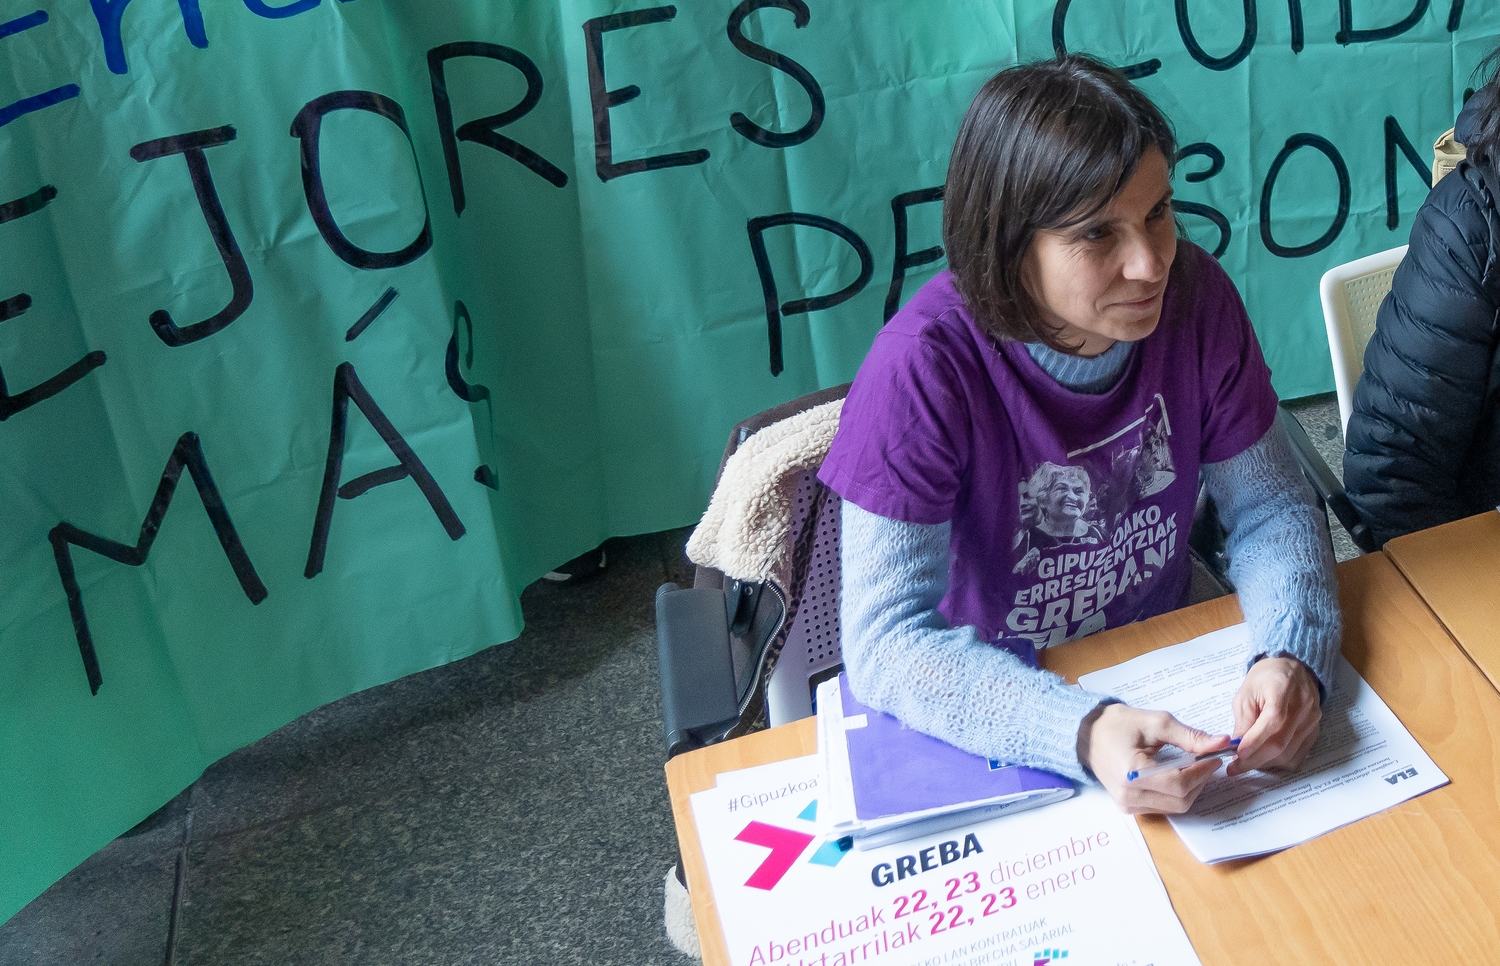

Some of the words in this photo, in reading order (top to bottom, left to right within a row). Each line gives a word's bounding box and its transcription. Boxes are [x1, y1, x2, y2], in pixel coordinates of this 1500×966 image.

[1037, 504, 1161, 580] GIPUZOAKO
[727, 774, 820, 813] #Gipuzkoa
[1383, 766, 1420, 786] ELA
[871, 831, 984, 888] GREBA
[749, 905, 886, 966] Abenduak
[892, 888, 939, 921] 22,
[944, 871, 981, 902] 23
[989, 830, 1111, 885] diciembre
[928, 904, 975, 937] 22,
[980, 885, 1018, 918] 23
[1026, 863, 1096, 901] enero
[944, 941, 968, 964] LAN
[970, 916, 1048, 953] KONTRATUAK
[1019, 922, 1076, 951] SALARIAL
